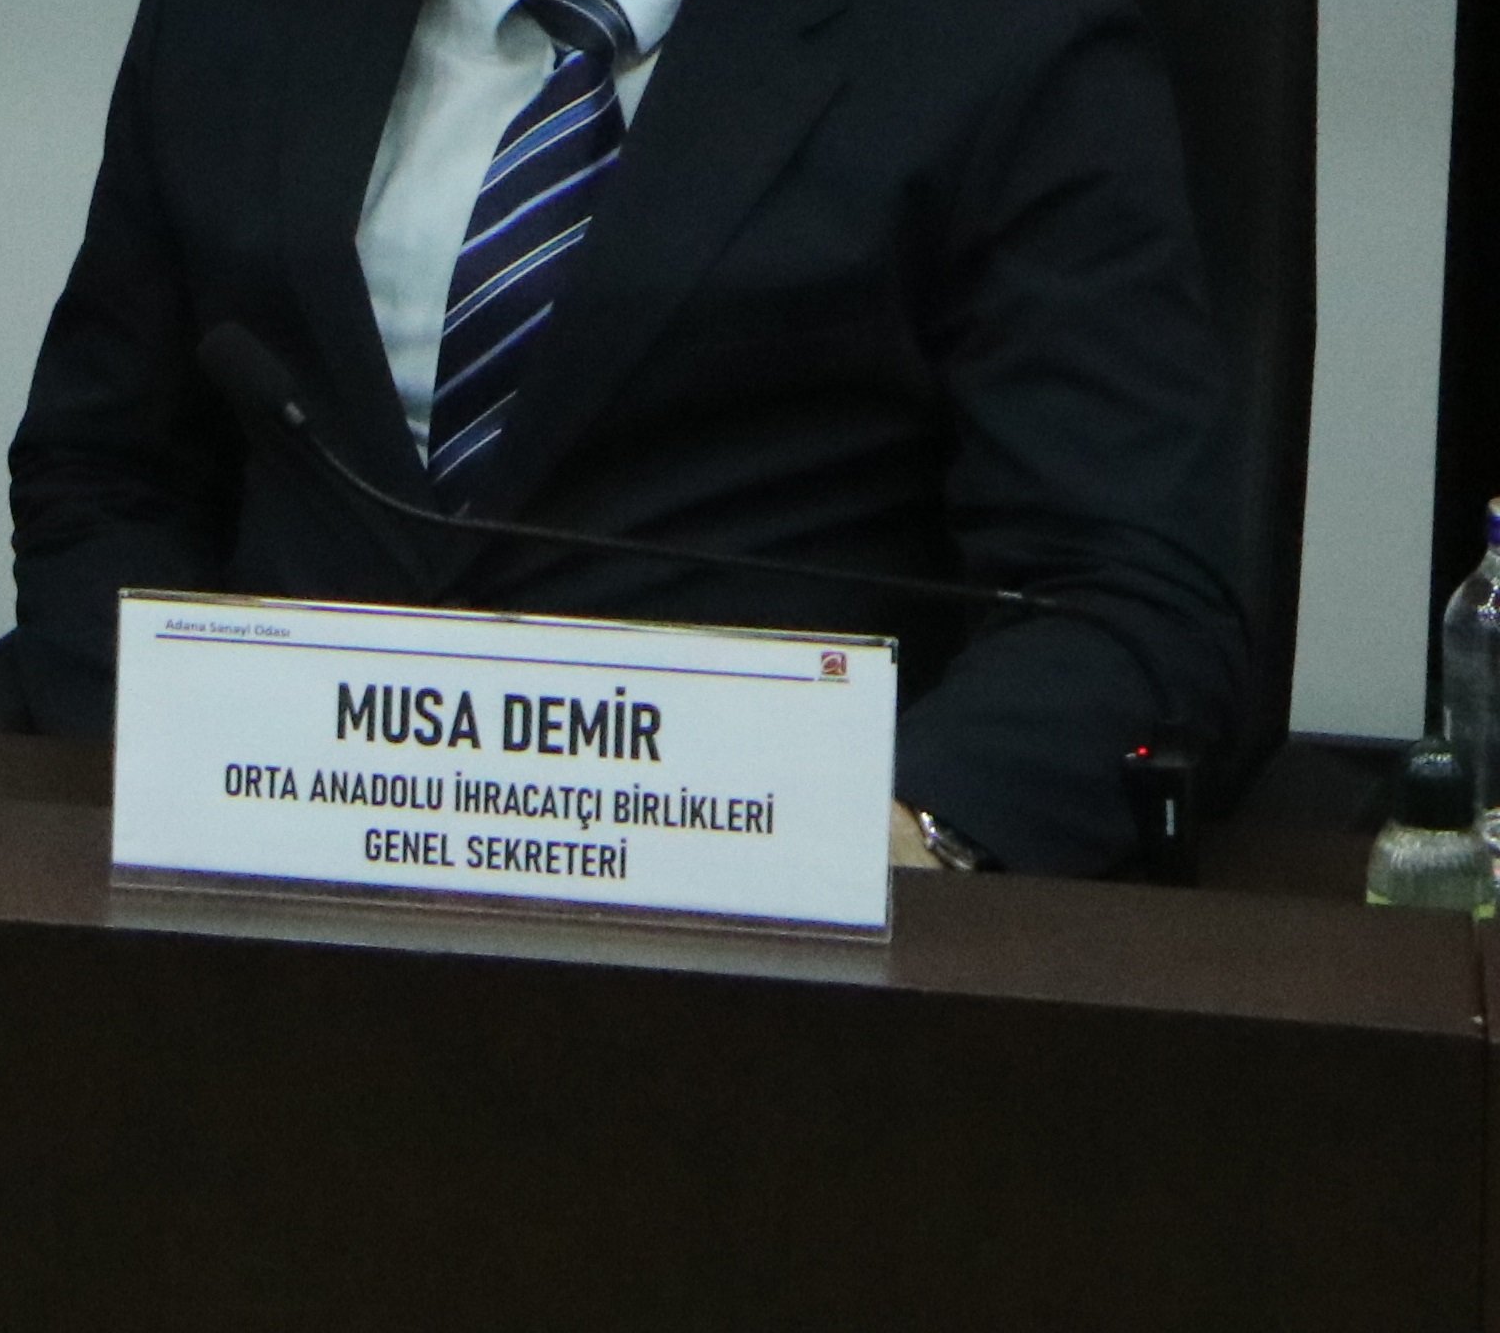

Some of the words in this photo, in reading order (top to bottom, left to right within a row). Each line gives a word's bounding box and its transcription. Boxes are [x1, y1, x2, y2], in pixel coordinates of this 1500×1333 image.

[336, 682, 481, 750] MUSA
[501, 686, 662, 762] DEMİR
[224, 763, 298, 801] ORTA
[309, 769, 443, 812] ANADOLU
[454, 771, 602, 831] İHRACATÇI
[613, 780, 774, 835] BİRLİKLERİ
[364, 827, 454, 868] GENEL
[466, 835, 627, 881] SEKRETERİ
